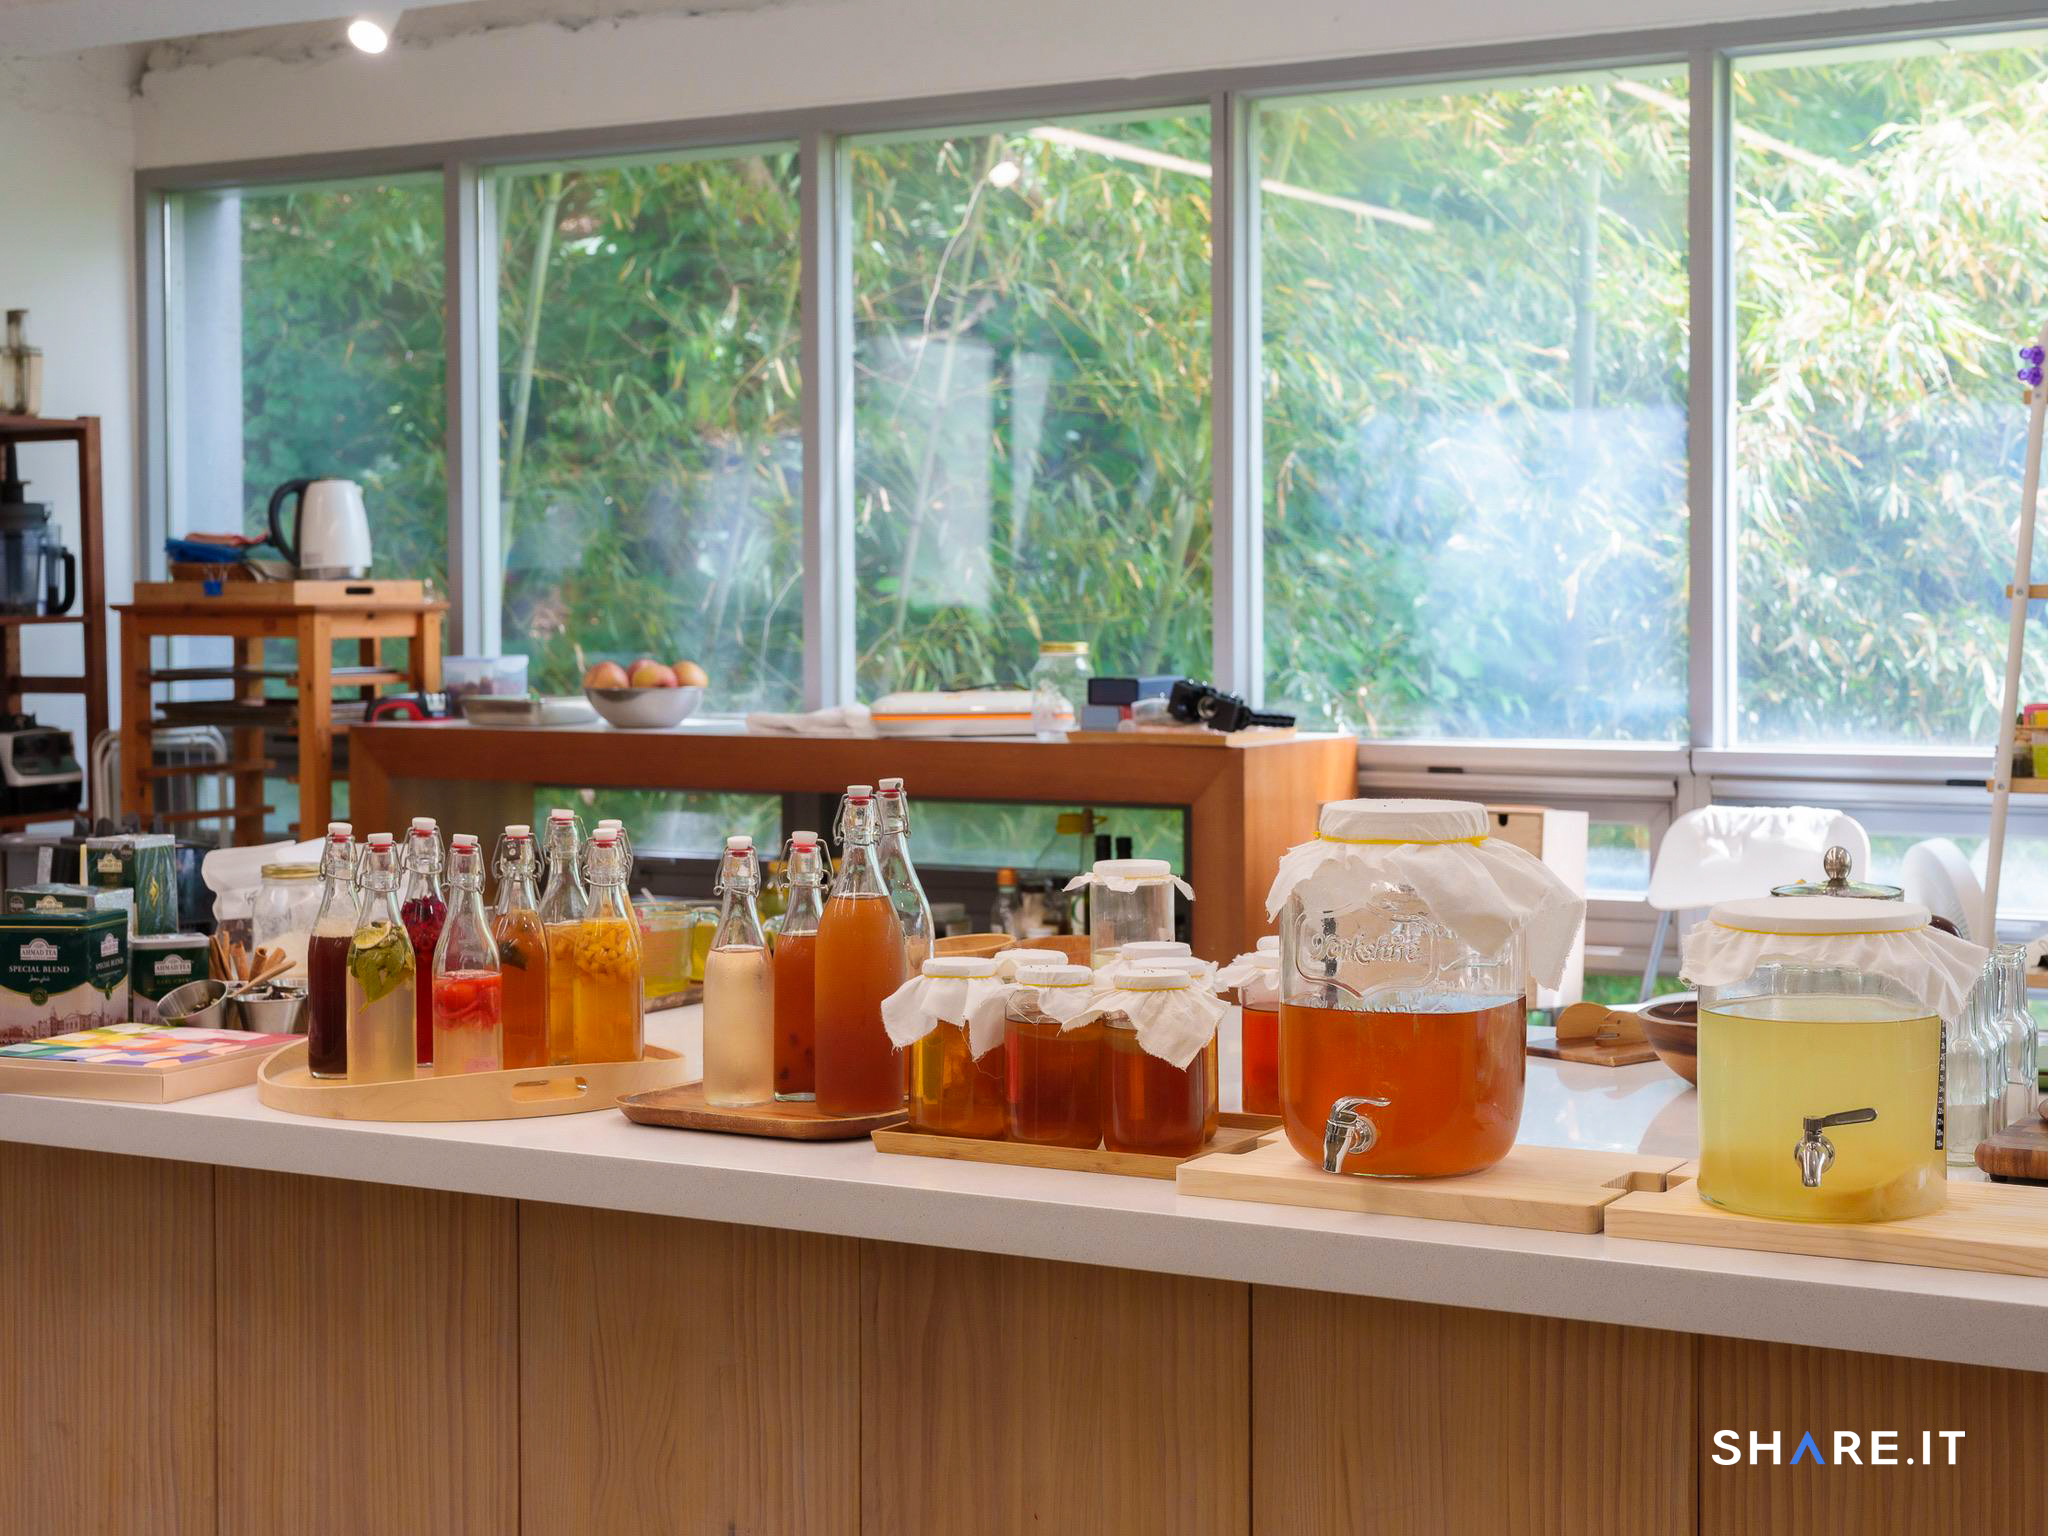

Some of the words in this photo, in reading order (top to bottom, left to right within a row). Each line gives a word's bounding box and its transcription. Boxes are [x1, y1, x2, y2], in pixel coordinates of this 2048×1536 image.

[45, 948, 57, 956] TEA
[8, 965, 40, 973] SPECIAL
[42, 965, 70, 973] BLEND
